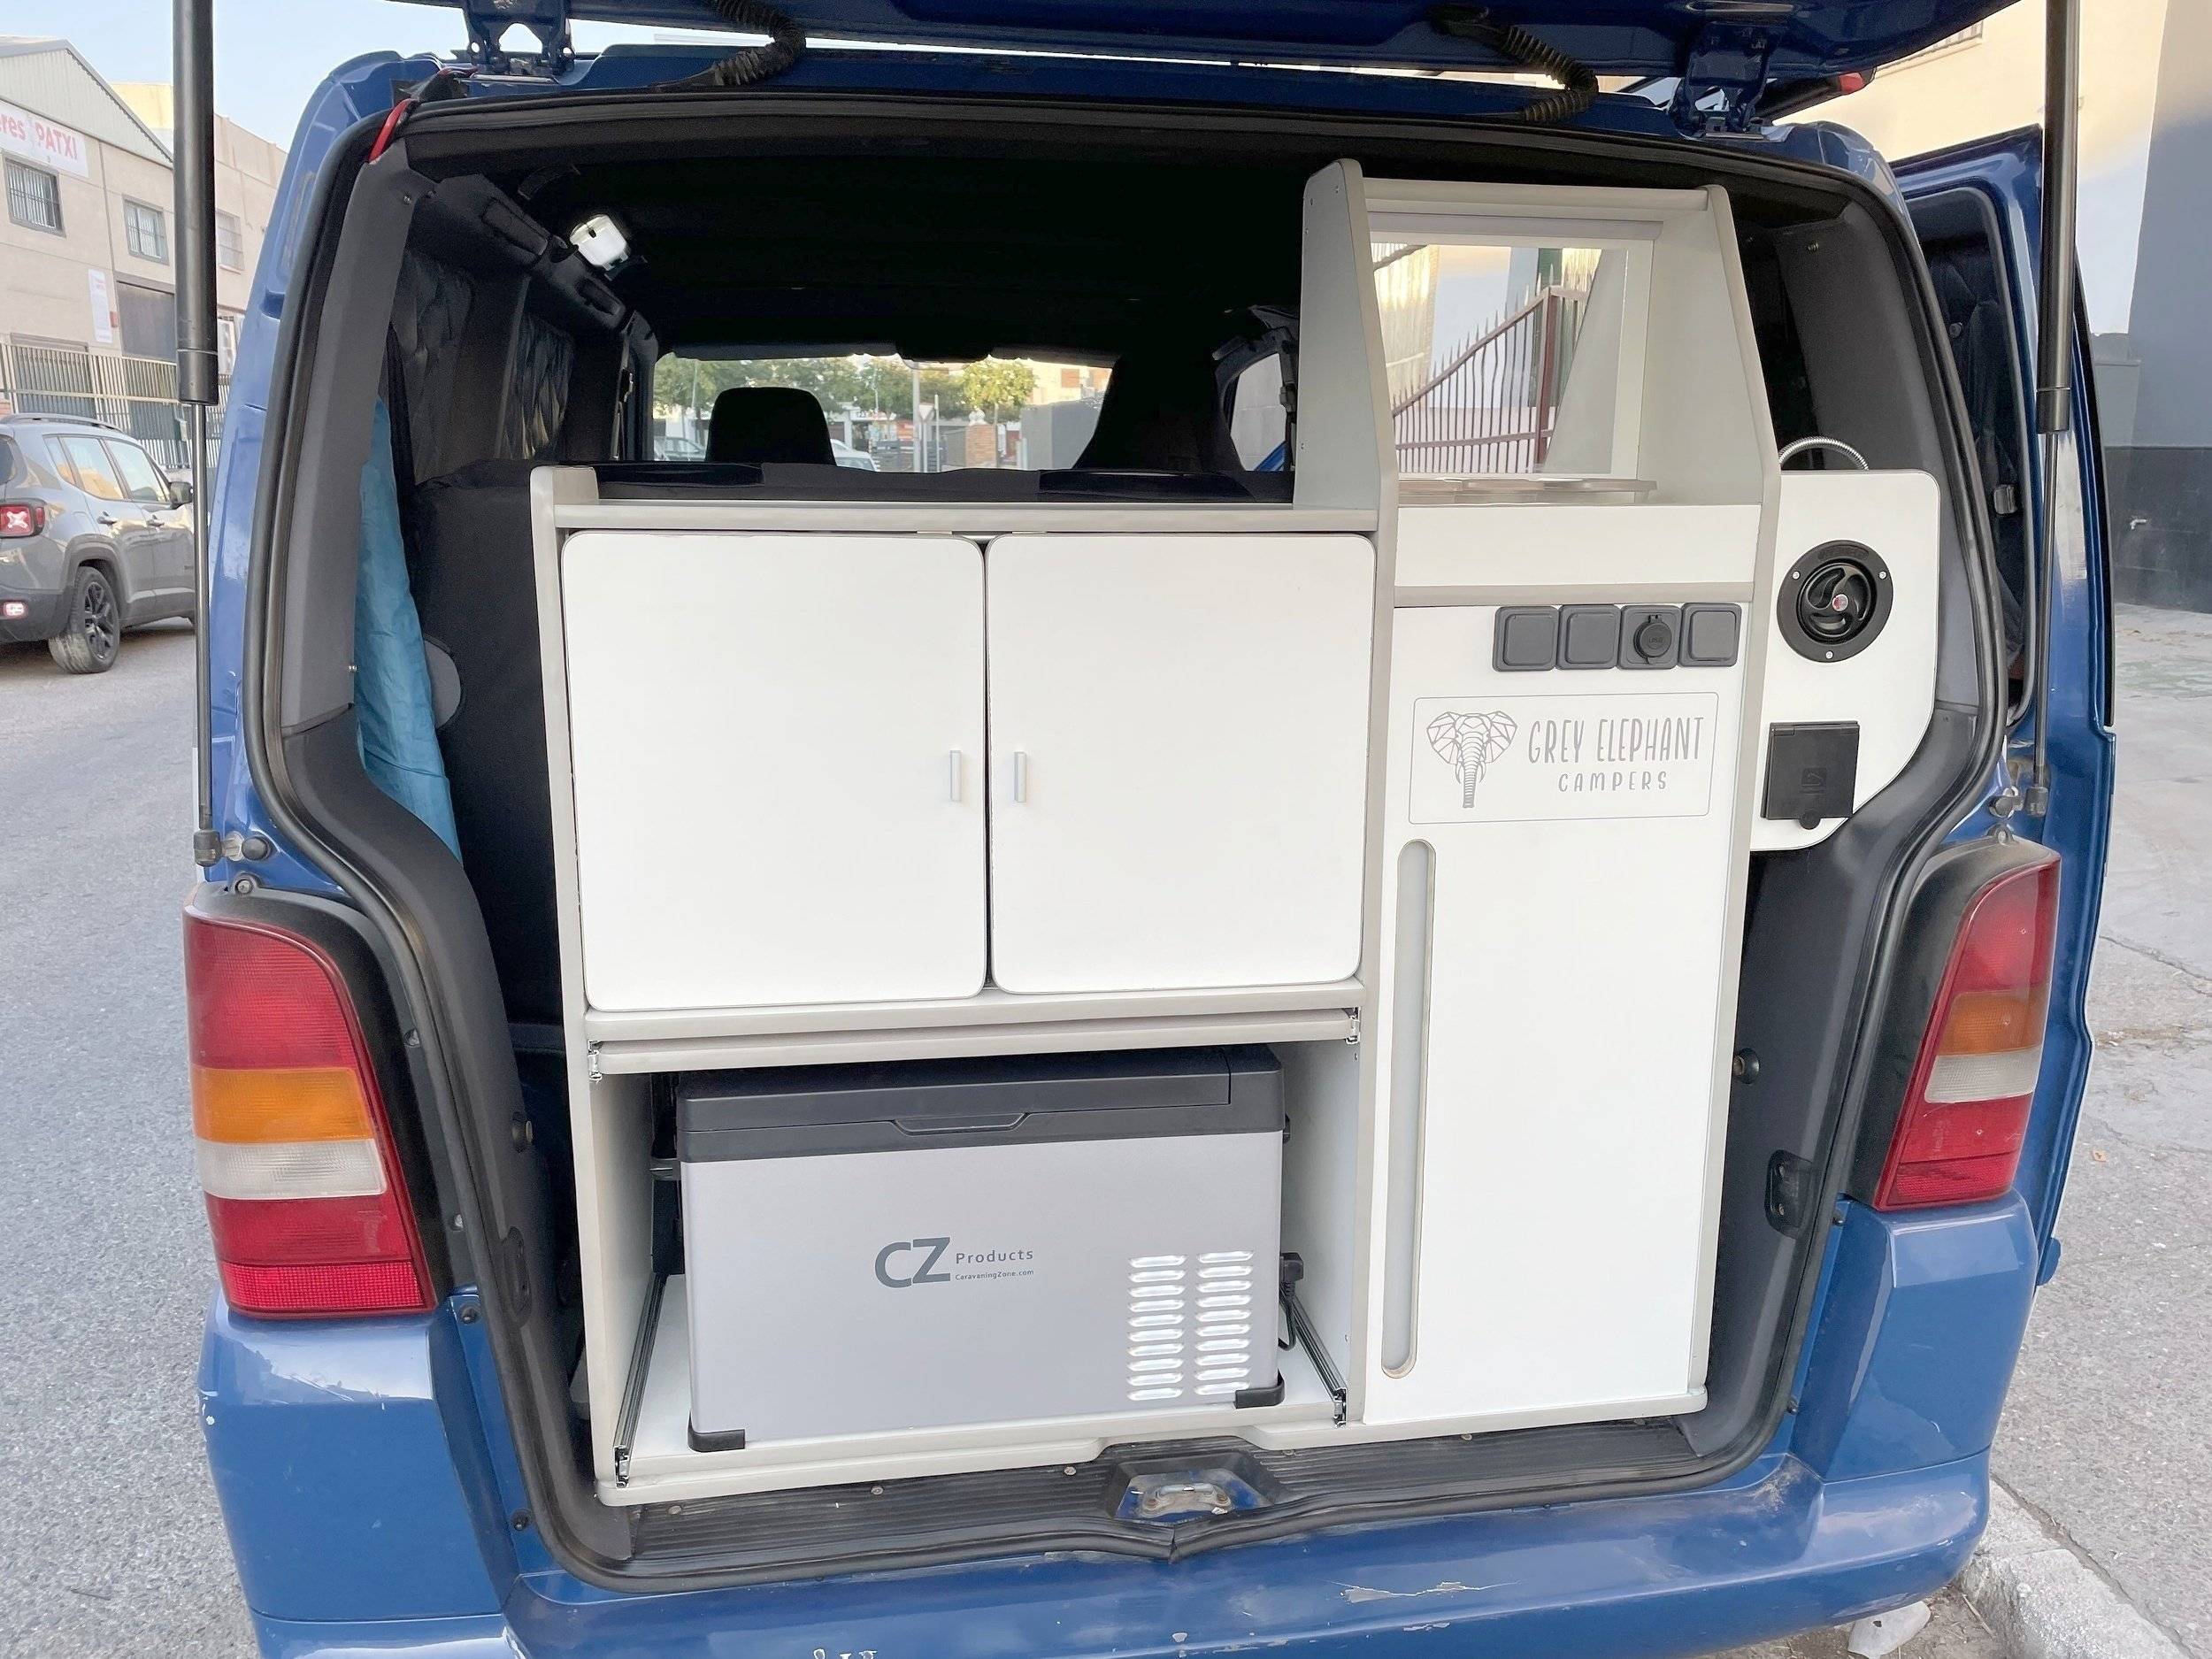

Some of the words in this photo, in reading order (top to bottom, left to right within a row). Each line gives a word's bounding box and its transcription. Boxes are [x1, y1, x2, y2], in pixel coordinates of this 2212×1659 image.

[0, 114, 26, 141] res
[35, 122, 78, 160] PATXI
[1528, 719, 1585, 764] GREY
[1596, 717, 1704, 763] ELEPHANT
[1558, 771, 1667, 792] CAMPERS
[874, 1236, 951, 1288] CZ
[955, 1249, 1033, 1264] Products
[955, 1269, 1034, 1280] CaravaningZone.com
